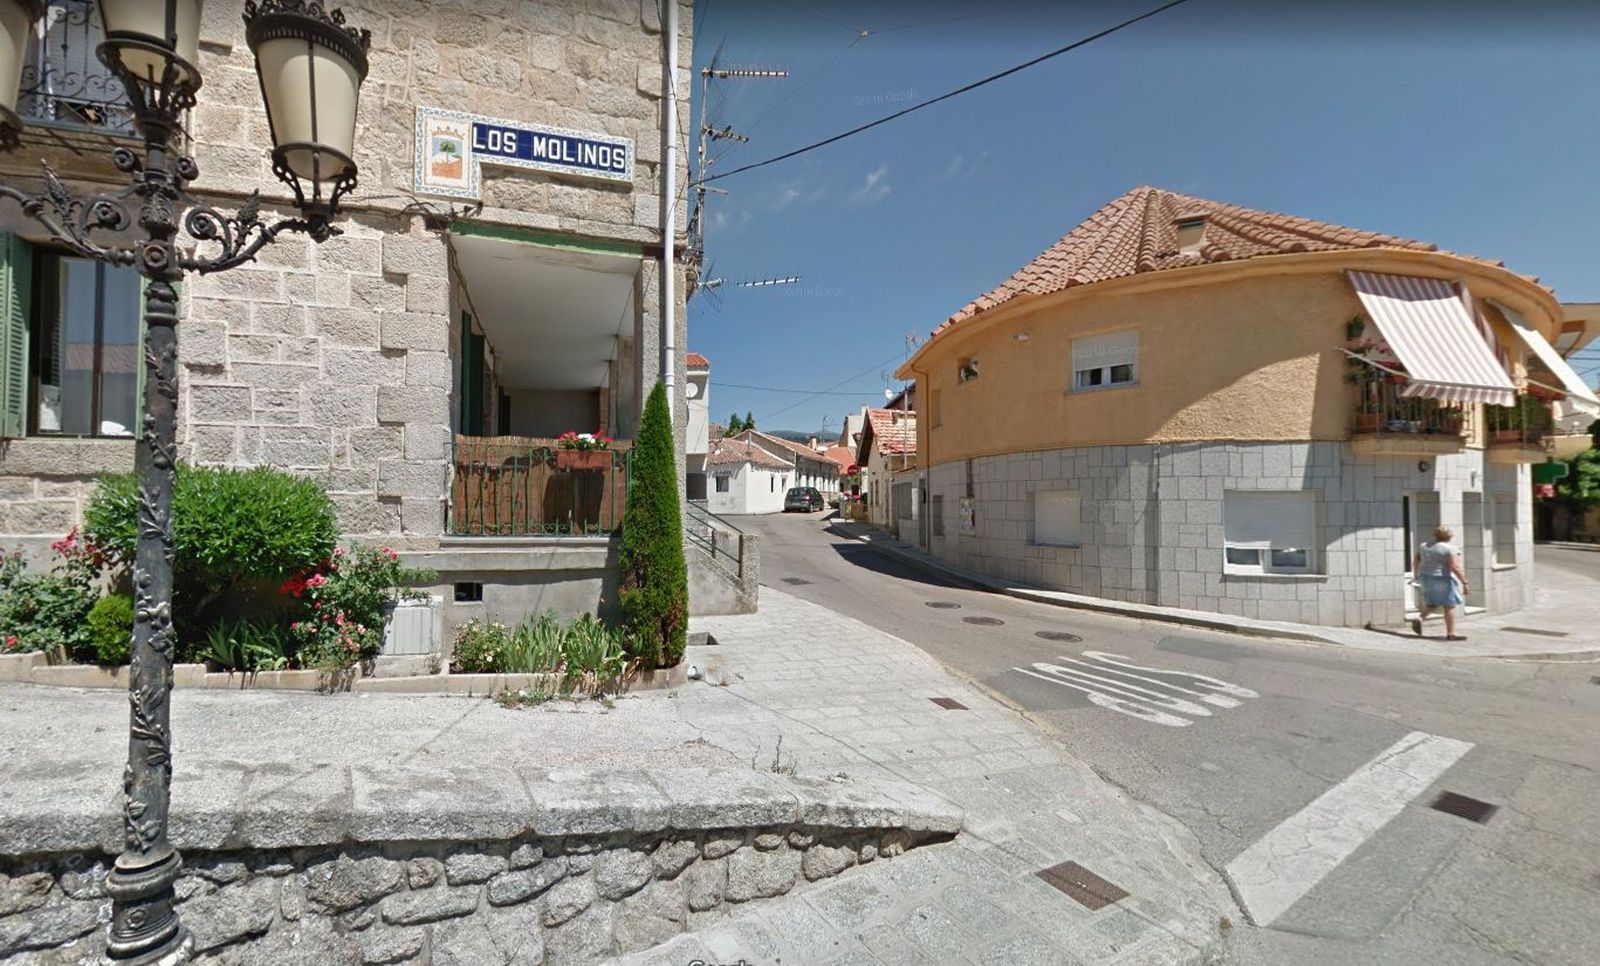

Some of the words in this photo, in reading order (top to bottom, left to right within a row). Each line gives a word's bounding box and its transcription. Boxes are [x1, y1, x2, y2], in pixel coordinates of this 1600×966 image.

[473, 126, 516, 153] LOS
[533, 135, 625, 169] MOLINOS
[1013, 650, 1260, 727] STOP
